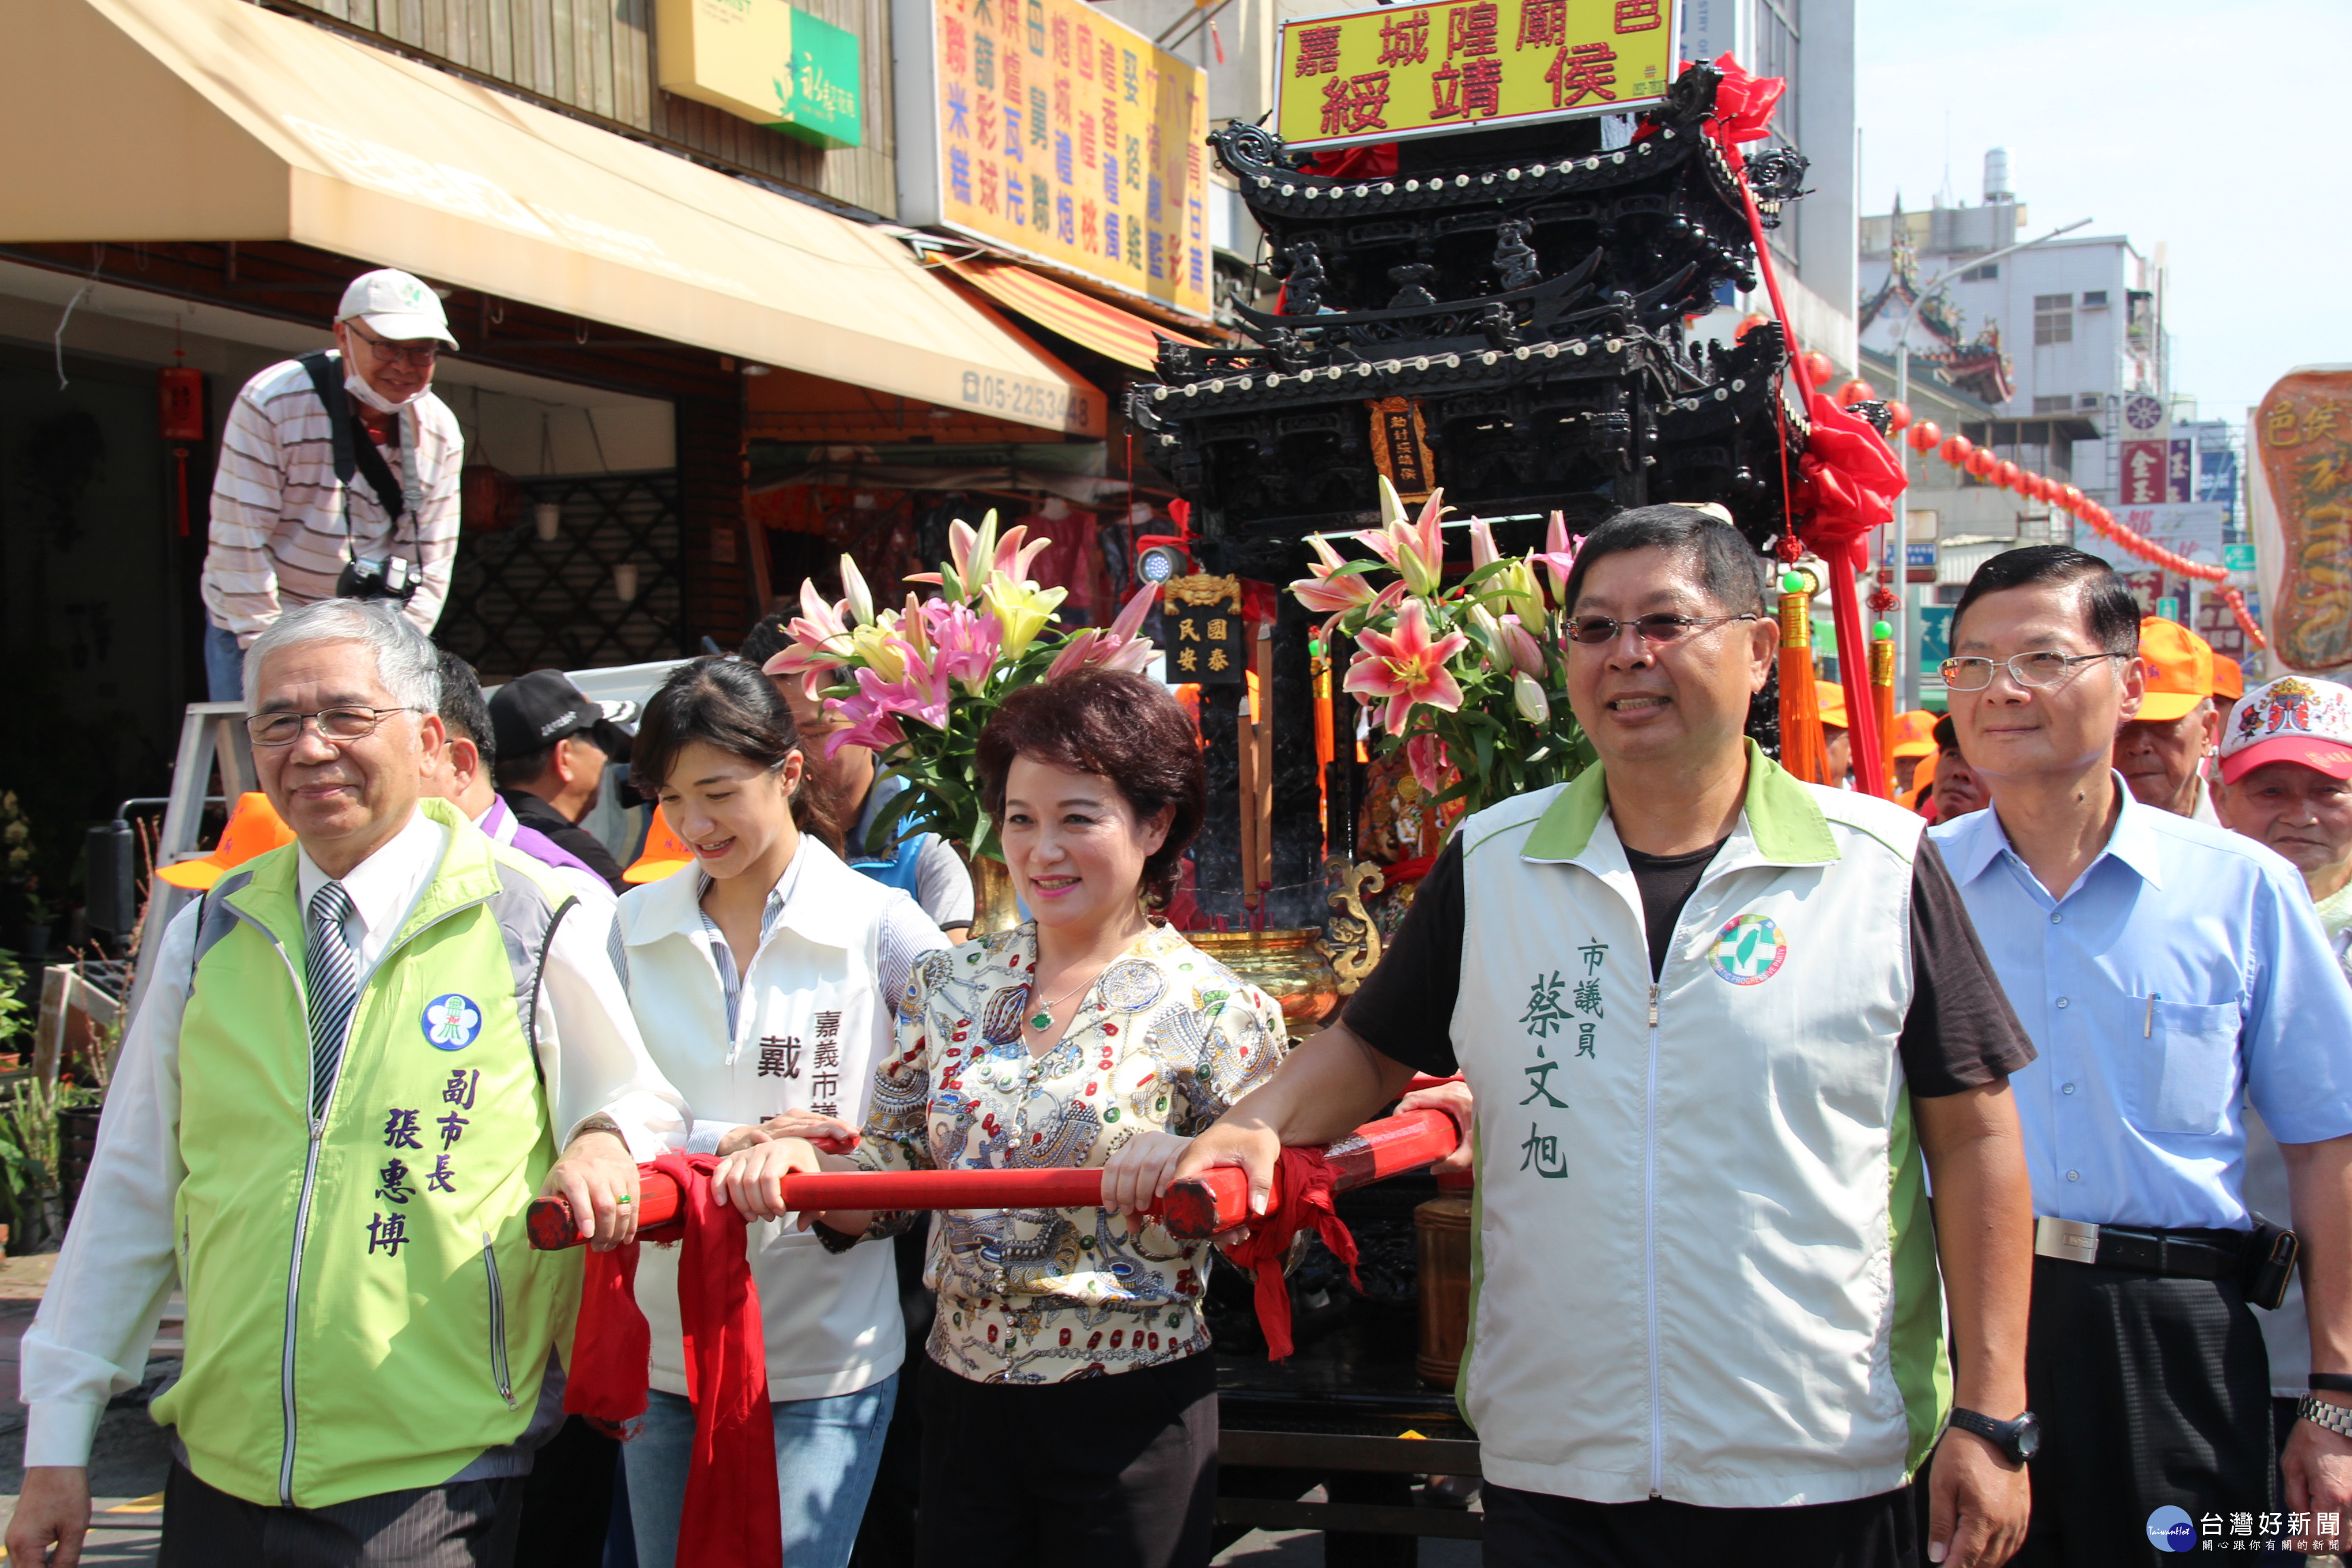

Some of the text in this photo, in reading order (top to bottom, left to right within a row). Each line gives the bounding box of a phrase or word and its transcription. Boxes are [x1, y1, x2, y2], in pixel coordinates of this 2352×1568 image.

[1320, 41, 1617, 135] 綏靖侯
[983, 375, 1089, 427] 05-2253448
[1177, 618, 1200, 672] 民安
[1207, 619, 1230, 672] 國泰
[1573, 936, 1609, 1060] 市議員
[1731, 966, 1776, 985] PROGRESSIVE
[1774, 948, 1786, 967] PARTY
[1518, 970, 1575, 1178] 蔡文旭
[425, 1069, 480, 1193] 副市長
[366, 1109, 424, 1258] 張惠博
